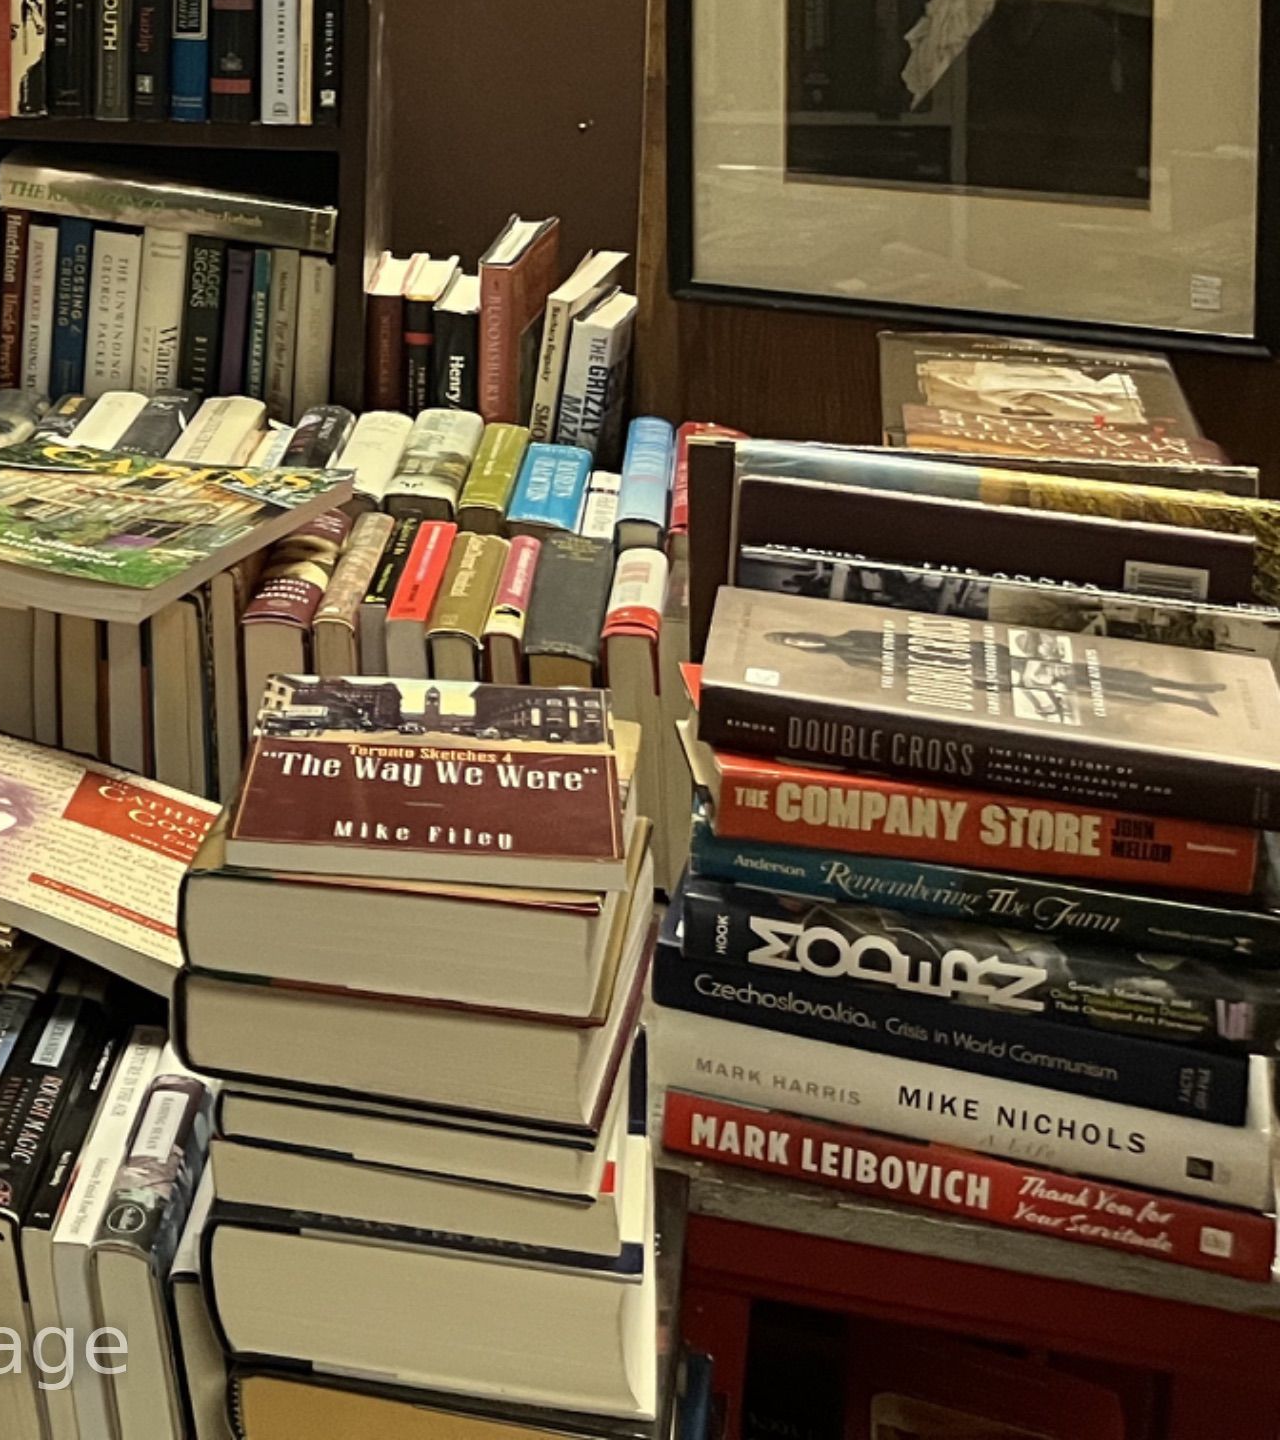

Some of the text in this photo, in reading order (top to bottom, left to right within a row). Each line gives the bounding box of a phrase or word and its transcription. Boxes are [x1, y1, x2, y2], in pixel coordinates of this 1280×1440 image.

[4, 215, 21, 282] Hutchison
[190, 248, 206, 307] SIGGINS
[206, 249, 220, 308] MAGGIE
[59, 258, 72, 326] CRUISING
[71, 244, 86, 320] CROSSING
[96, 255, 112, 377] GEORGE PACKER
[111, 291, 127, 380] UNWINDING
[446, 356, 465, 401] Henry
[579, 337, 607, 439] THE GRIZZLY
[348, 744, 512, 764] Toronto Sketches 4
[354, 756, 423, 788] Way
[437, 760, 484, 786] We
[787, 716, 975, 777] DOUBLE CROSS
[334, 820, 514, 851] Mike Filey
[733, 782, 1102, 858] THE COMPANY STORE
[1111, 817, 1155, 842] JOHN
[733, 853, 983, 915] Anderson Remembering
[984, 886, 1029, 920] The
[715, 915, 728, 955] HOOK
[748, 915, 1048, 1011] MODERN
[884, 1017, 1119, 1083] Crisis World Communism
[9, 1075, 64, 1164] ROUGH MAGIC
[696, 1058, 1147, 1155] MARK HARRIS MIKE NICHOLS
[689, 1113, 990, 1210] MARK LEIBOVICH
[1012, 1203, 1173, 1254] Your Servitude
[1017, 1176, 1173, 1226] Thank You for
